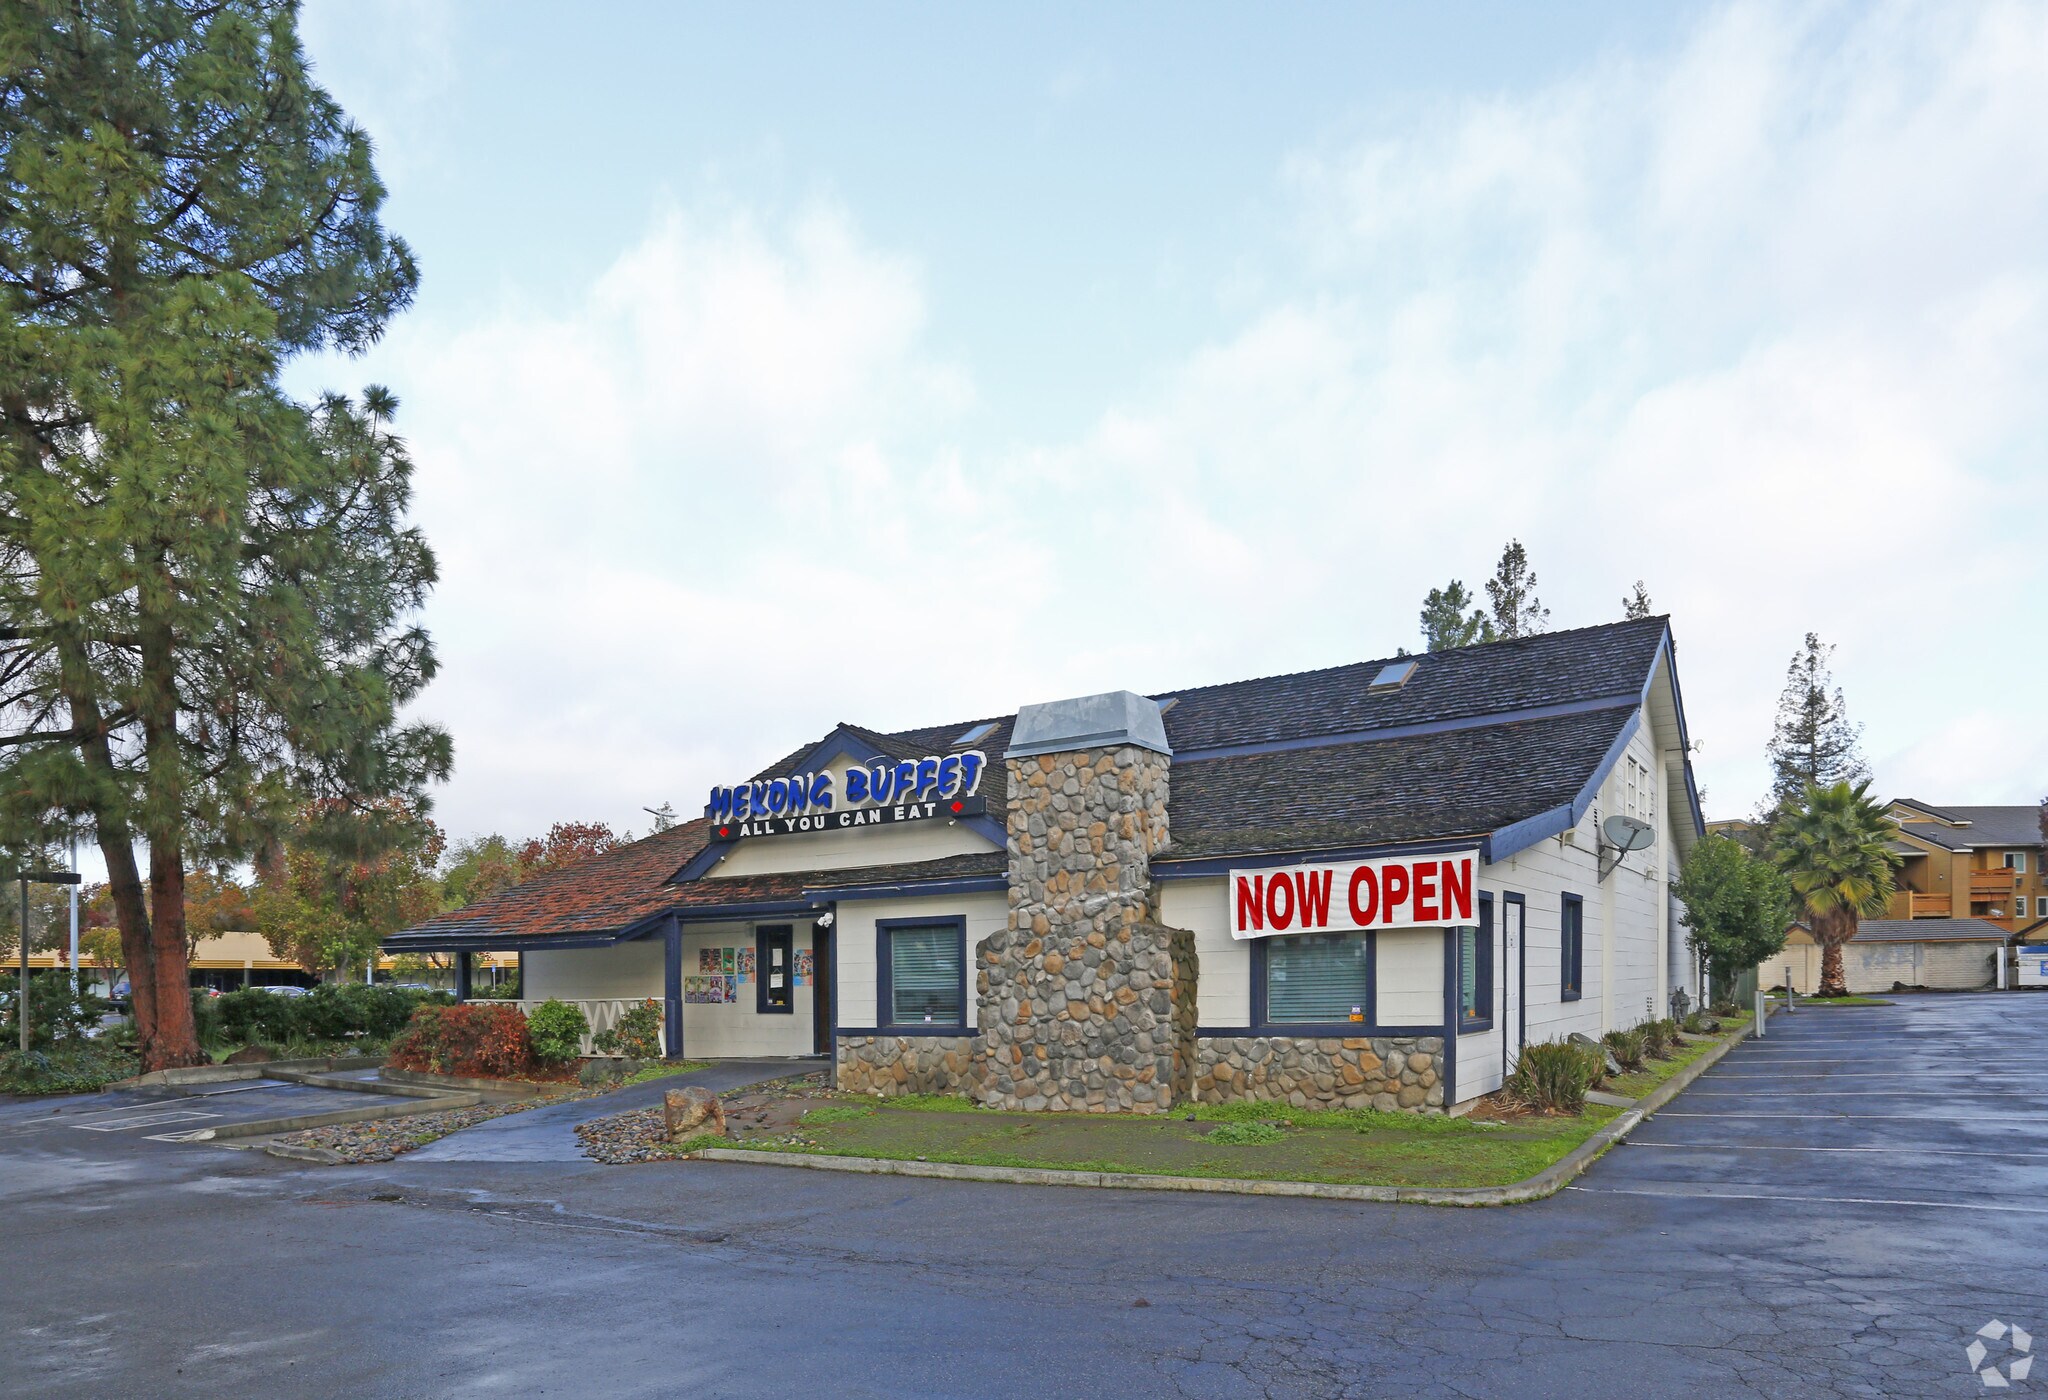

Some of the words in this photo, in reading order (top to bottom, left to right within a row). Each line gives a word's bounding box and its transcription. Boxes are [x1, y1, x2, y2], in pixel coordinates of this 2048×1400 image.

[710, 771, 835, 820] MEKONG
[846, 752, 985, 803] BUFFET
[740, 820, 775, 837] ALL
[786, 815, 825, 832] YOU
[839, 809, 881, 827] CAN
[895, 803, 937, 820] EAT
[1237, 869, 1333, 931] NOW
[1348, 859, 1472, 926] OPEN
